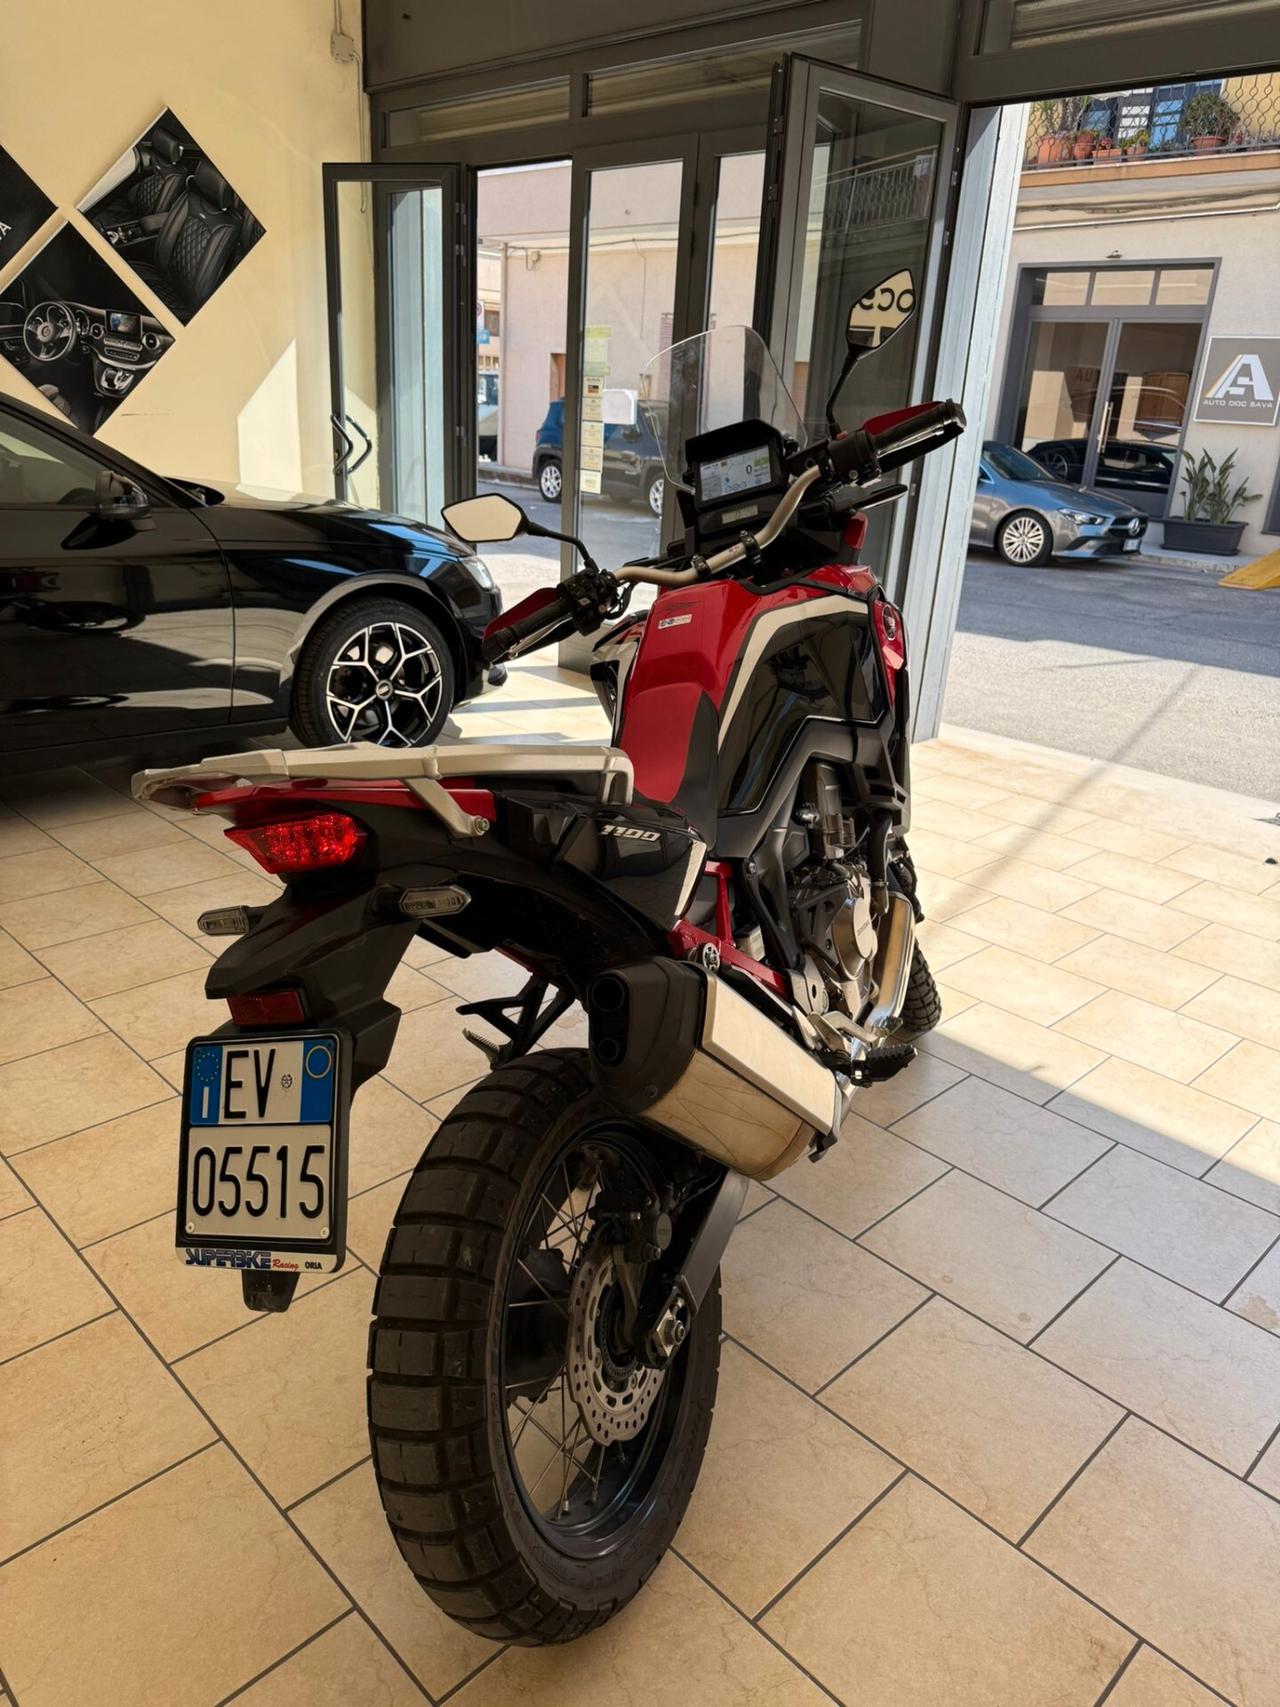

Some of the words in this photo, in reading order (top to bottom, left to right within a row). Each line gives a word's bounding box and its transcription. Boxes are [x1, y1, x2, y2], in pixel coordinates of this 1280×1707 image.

[601, 825, 661, 841] 1100
[224, 1049, 276, 1119] EV
[192, 1144, 325, 1219] 05515
[272, 1259, 300, 1271] Racing
[304, 1261, 323, 1270] ORIA
